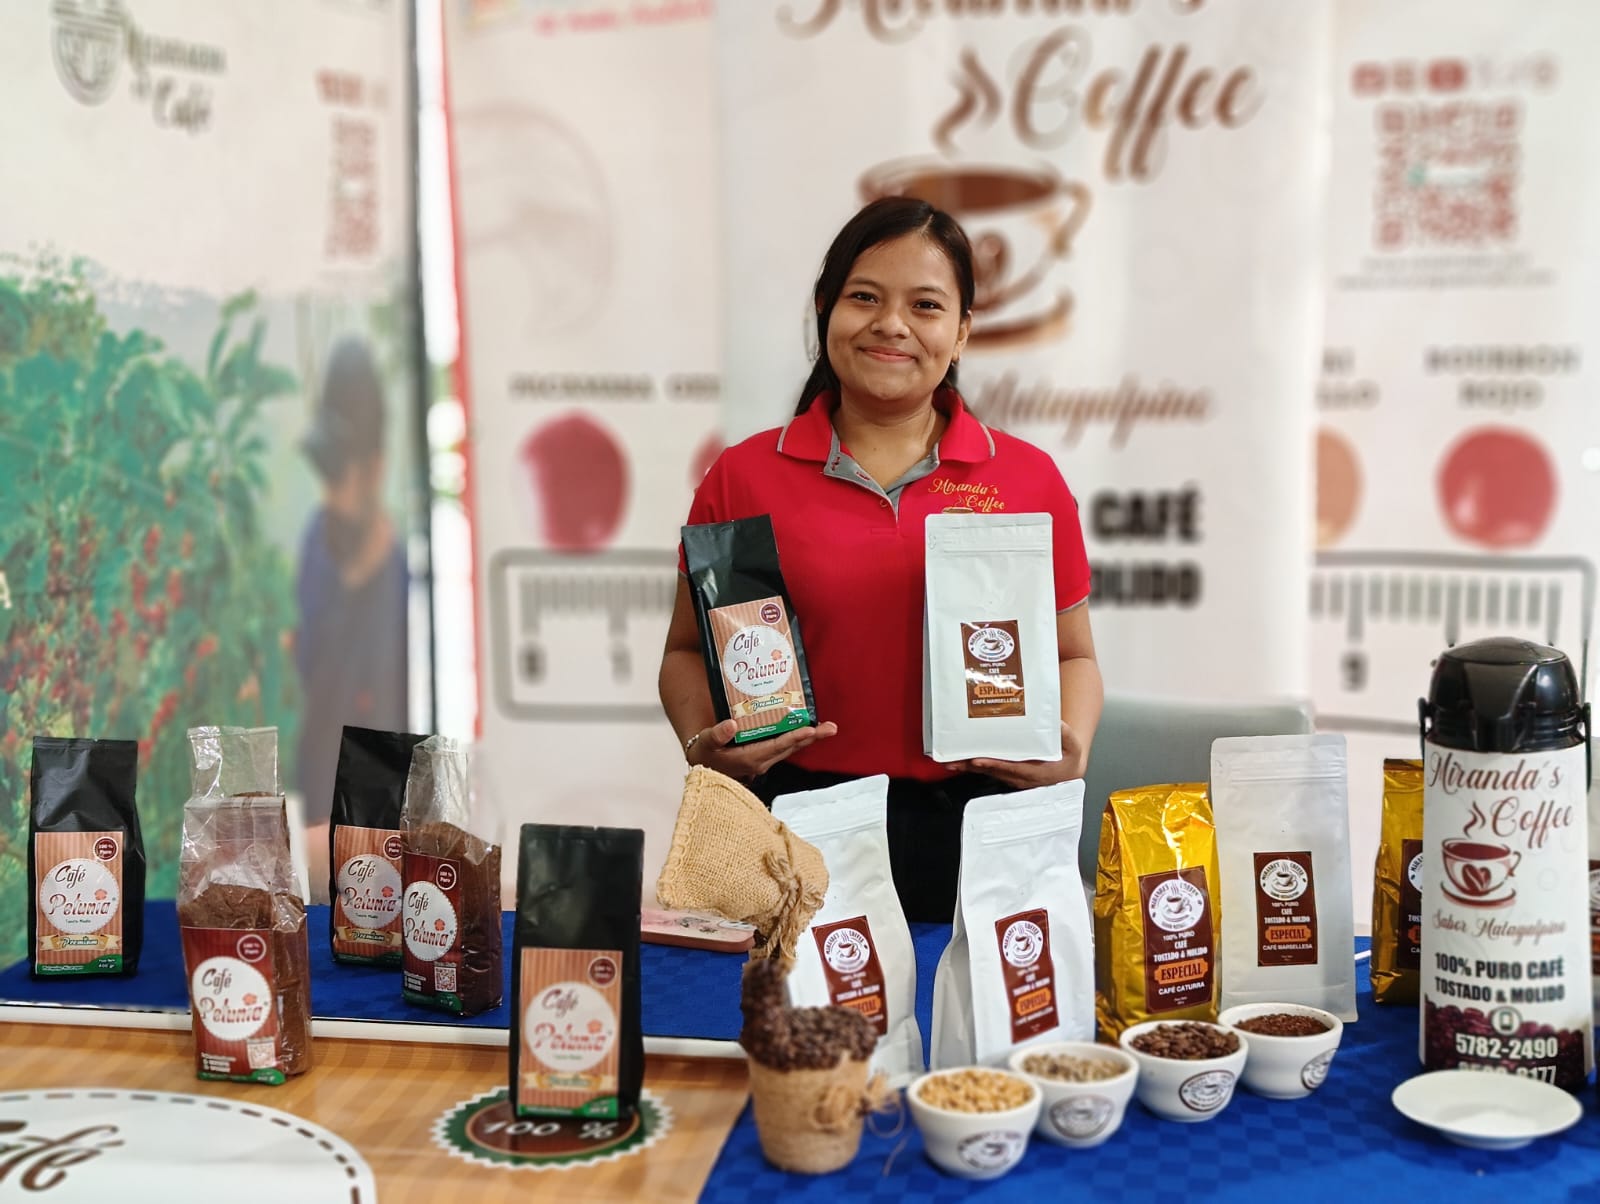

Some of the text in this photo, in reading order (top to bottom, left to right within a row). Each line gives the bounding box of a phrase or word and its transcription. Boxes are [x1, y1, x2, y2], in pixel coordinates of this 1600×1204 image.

[1008, 24, 1262, 186] Coffee
[965, 495, 1005, 512] Coffee
[1092, 484, 1201, 543] CAFÉ
[1089, 563, 1202, 609] OLIDO
[733, 631, 760, 655] Café
[752, 696, 784, 711] Premium
[1491, 796, 1572, 848] Coffee
[55, 864, 86, 888] Café
[348, 860, 375, 883] Café
[408, 891, 429, 916] Café
[1432, 909, 1467, 932] Sabor
[61, 936, 98, 948] Premium
[1174, 940, 1187, 949] CAFÉ
[1271, 928, 1306, 940] ESPECIAL
[1154, 946, 1208, 962] TOSTADO & MOLIDO
[1435, 953, 1564, 979] 100% PURO CAFÉ
[202, 968, 232, 995] Café
[1161, 964, 1203, 981] ESPECIAL
[1159, 981, 1205, 995] CAFÉ CATURRA
[1435, 977, 1565, 1002] TOSTADO & MOLIDO
[542, 989, 577, 1017] Café
[1456, 1033, 1558, 1059] 5782-2490
[483, 1120, 618, 1140] 100 %
